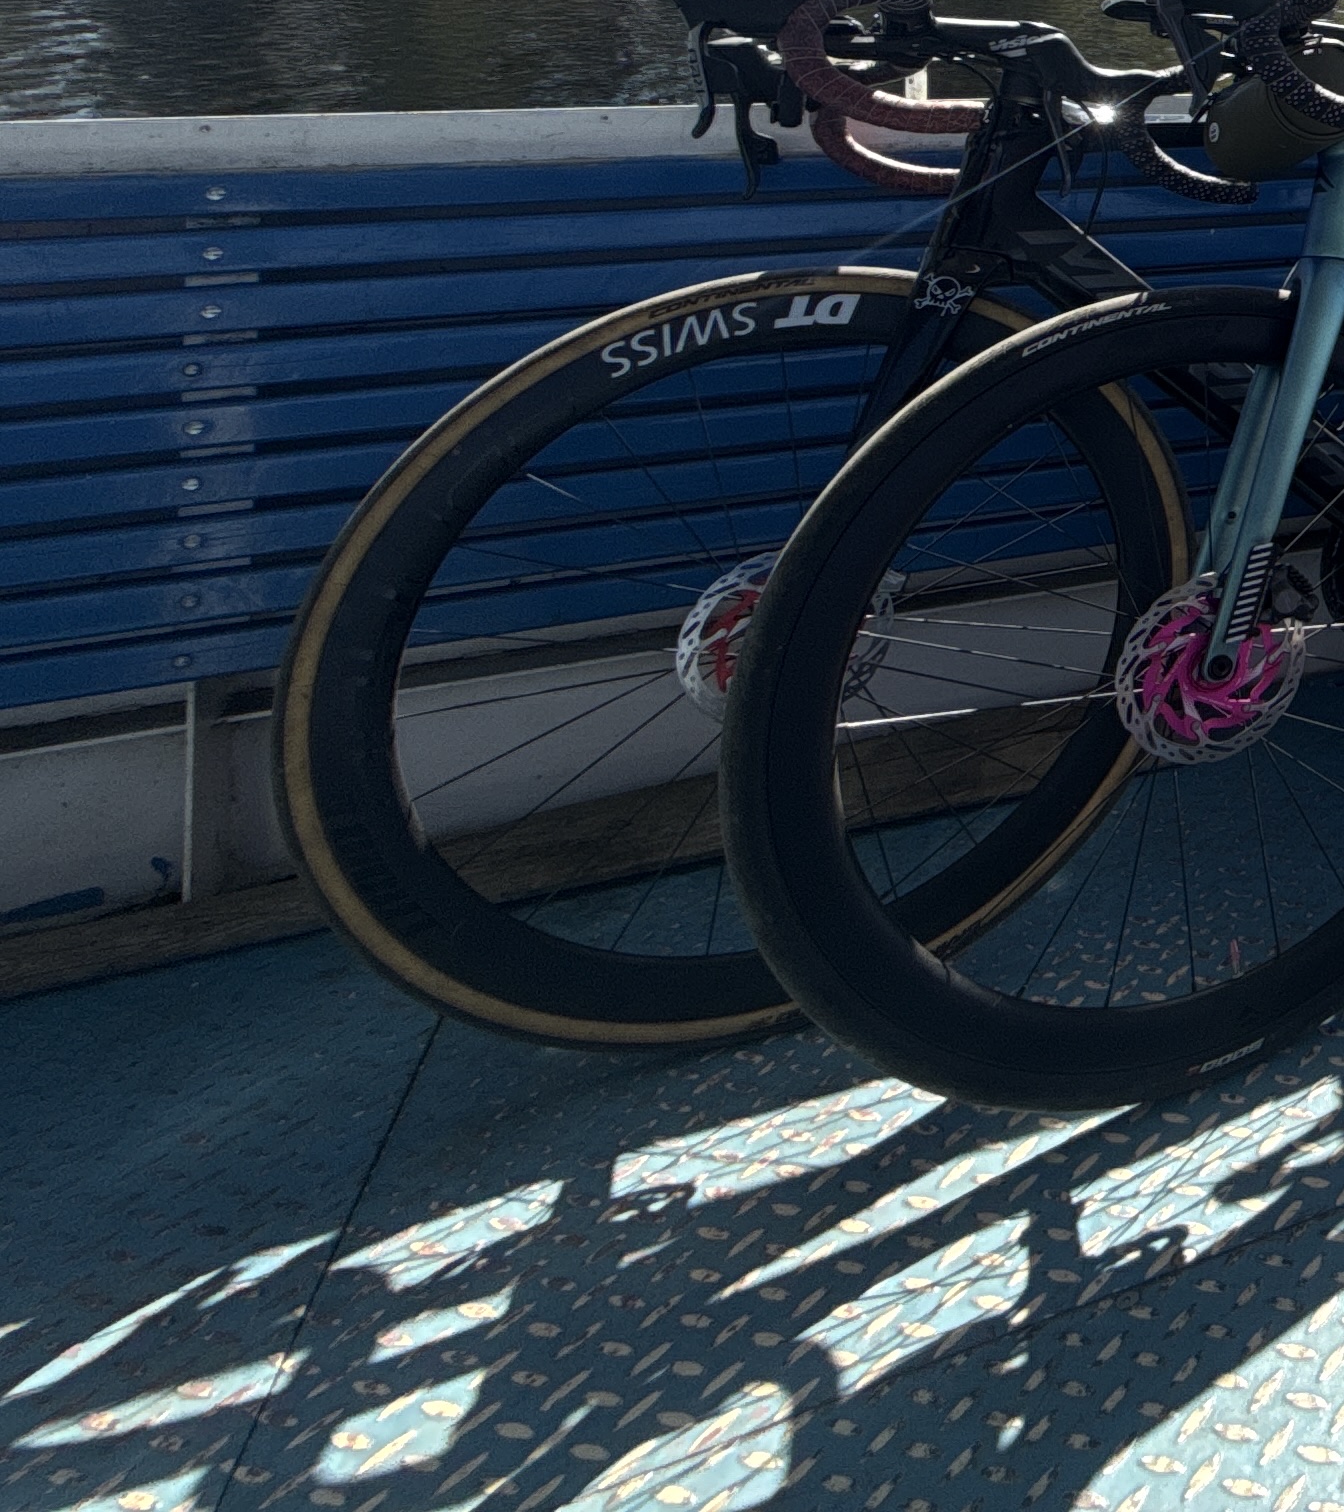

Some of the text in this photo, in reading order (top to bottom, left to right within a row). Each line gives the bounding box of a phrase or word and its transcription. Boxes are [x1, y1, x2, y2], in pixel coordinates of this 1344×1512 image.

[648, 277, 815, 318] CONTINENTAL
[601, 293, 861, 379] DT SWISS
[1021, 302, 1173, 358] CONTINENTAL
